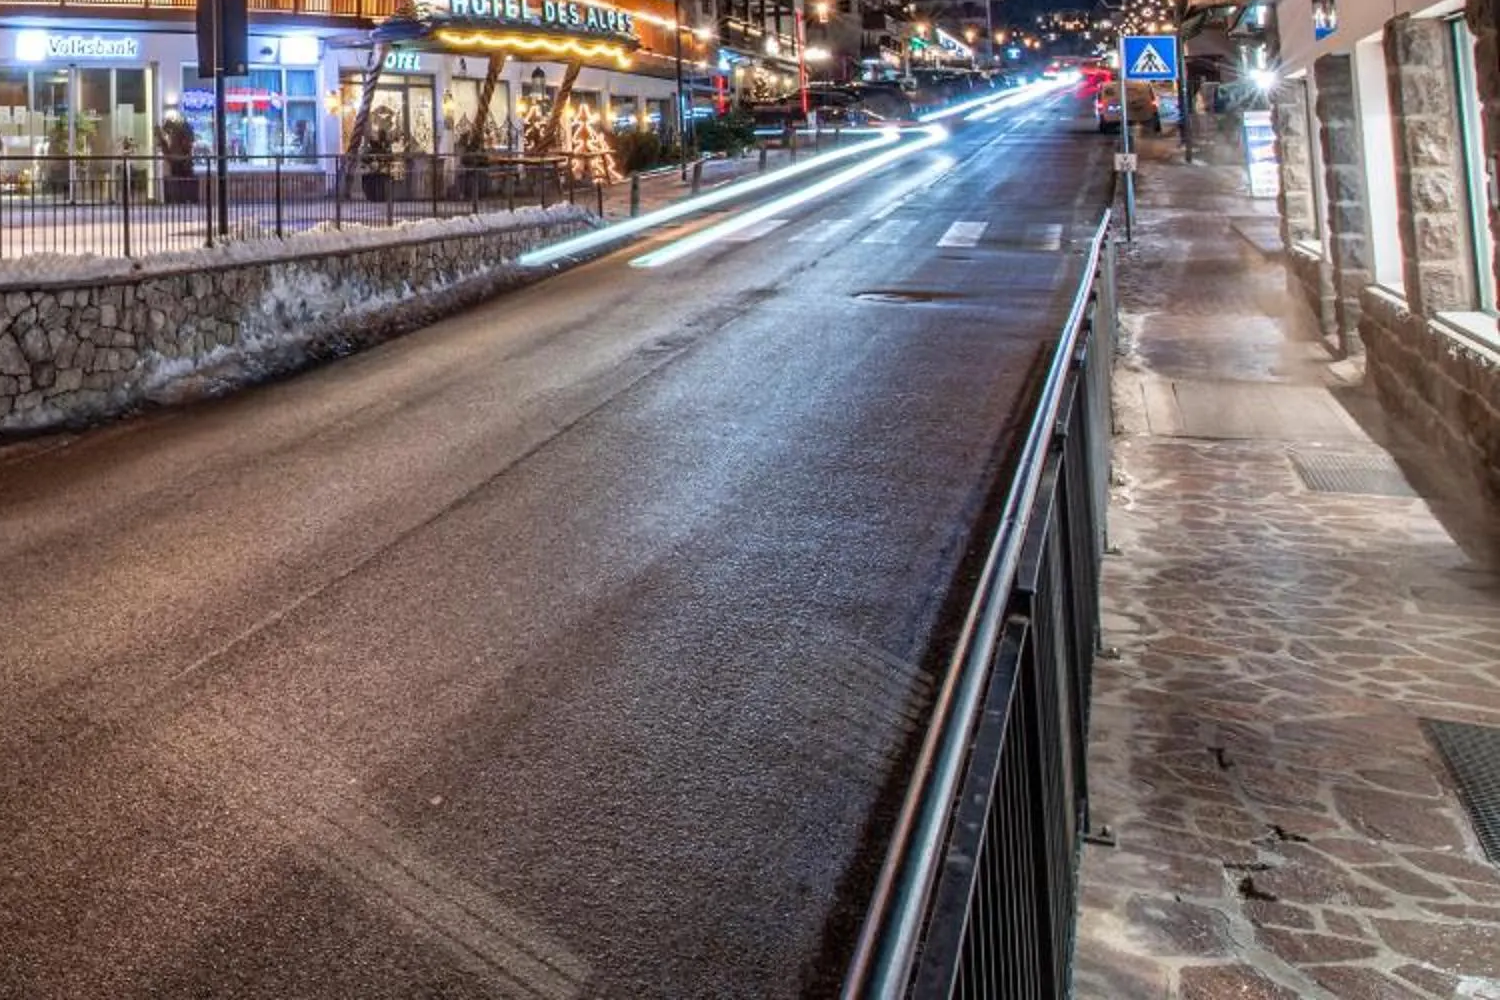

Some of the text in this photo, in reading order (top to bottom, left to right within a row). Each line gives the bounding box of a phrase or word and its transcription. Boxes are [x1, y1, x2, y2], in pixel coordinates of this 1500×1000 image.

[544, 0, 581, 26] DES
[586, 7, 636, 33] ALPES
[48, 36, 138, 56] Volksbank
[383, 51, 421, 71] OTEL
